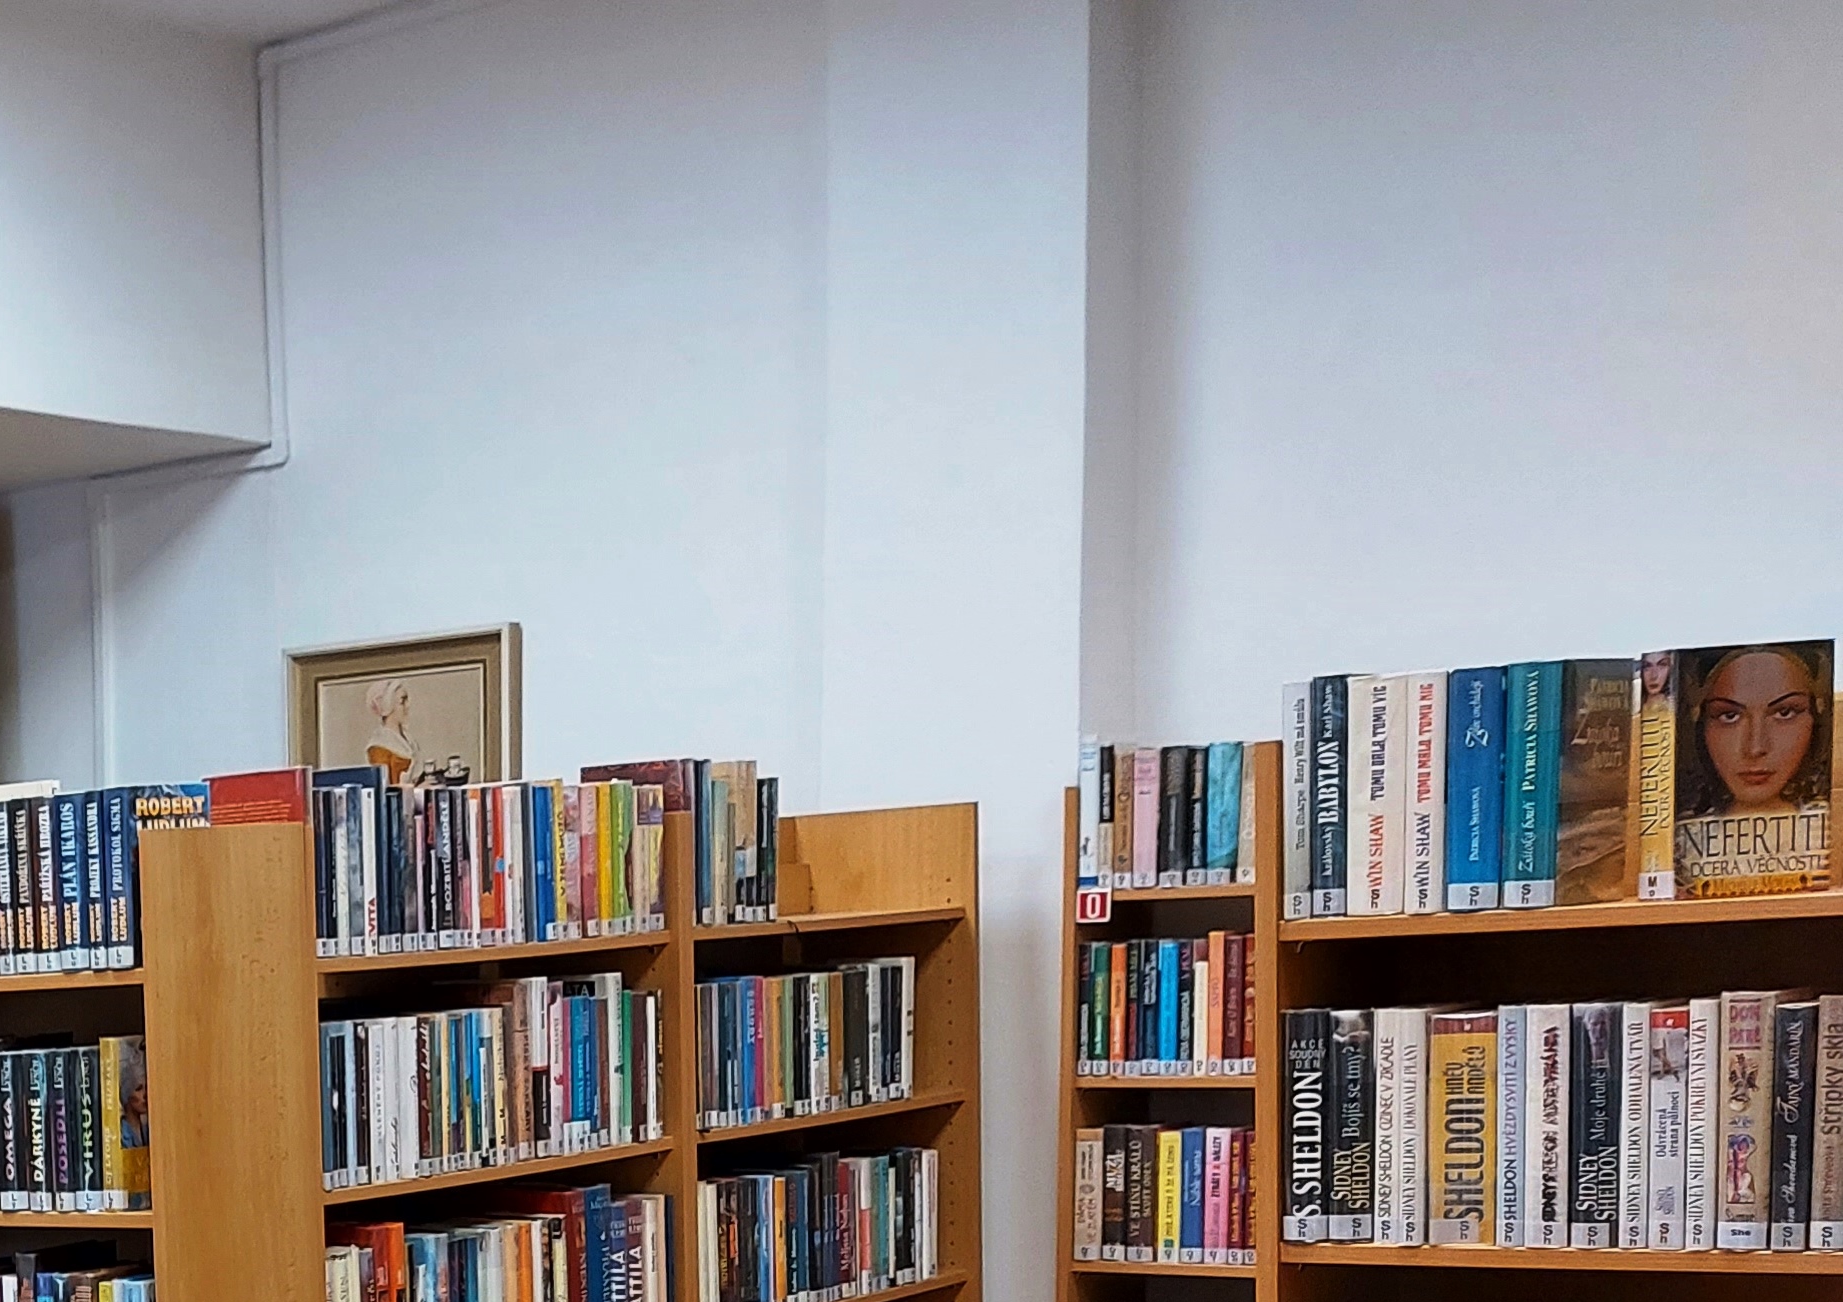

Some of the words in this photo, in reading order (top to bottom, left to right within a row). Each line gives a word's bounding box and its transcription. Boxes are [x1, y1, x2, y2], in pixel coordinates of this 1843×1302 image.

[1323, 715, 1332, 738] Karl
[1371, 706, 1386, 737] TOMU
[1418, 704, 1432, 736] TOMU
[1522, 734, 1538, 790] PATRICIA
[1641, 716, 1659, 837] NEFERTITI
[1317, 741, 1339, 824] BABYLON
[1370, 770, 1385, 800] TOMU
[1417, 772, 1431, 803] TOMU
[135, 796, 205, 816] ROBERT
[60, 803, 76, 856] IKAROS
[1368, 814, 1383, 856] SHAW
[1414, 812, 1430, 856] SHAW
[1683, 813, 1827, 858] NEFERTITI
[60, 859, 78, 897] PLÁN
[1648, 877, 1657, 886] M
[1691, 859, 1740, 878] DCERA
[1749, 854, 1823, 872] VĚČNOSTI
[1086, 893, 1101, 919] O
[1291, 1039, 1326, 1049] AKCE
[1820, 1024, 1840, 1059] skla
[1342, 1045, 1366, 1079] tmy?
[1347, 1084, 1360, 1099] se
[1590, 1073, 1605, 1107] druhé
[1667, 1091, 1681, 1126] půlnoci
[1341, 1103, 1365, 1138] Bojíš
[1379, 1093, 1392, 1131] CIZINEC
[1502, 1104, 1516, 1156] HVĚZDY
[1590, 1110, 1609, 1140] Moje
[3, 1097, 15, 1181] OMEGA
[28, 1097, 44, 1182] DÁRKYNĚ
[80, 1094, 93, 1184] VIRUS
[1293, 1070, 1322, 1194] SHELDON
[1655, 1109, 1667, 1157] Odvrácená
[1669, 1129, 1679, 1158] strana
[1379, 1135, 1392, 1181] SHELDON
[1402, 1138, 1416, 1184] SHELDON
[1443, 1098, 1485, 1221] SHELDON
[1627, 1127, 1641, 1180] SHELDON
[1689, 1125, 1705, 1181] SHELDON
[1330, 1148, 1351, 1200] SIDNEY
[1348, 1142, 1371, 1209] SHELDON
[1503, 1159, 1516, 1220] SHELDON
[1575, 1153, 1598, 1211] SIDNEY
[1595, 1146, 1618, 1220] SHELDON
[1292, 1199, 1322, 1217] S.
[1379, 1183, 1392, 1217] SIDNEY
[1627, 1181, 1641, 1222] SIDNEY
[1297, 1219, 1307, 1230] S
[1731, 1227, 1751, 1237] She
